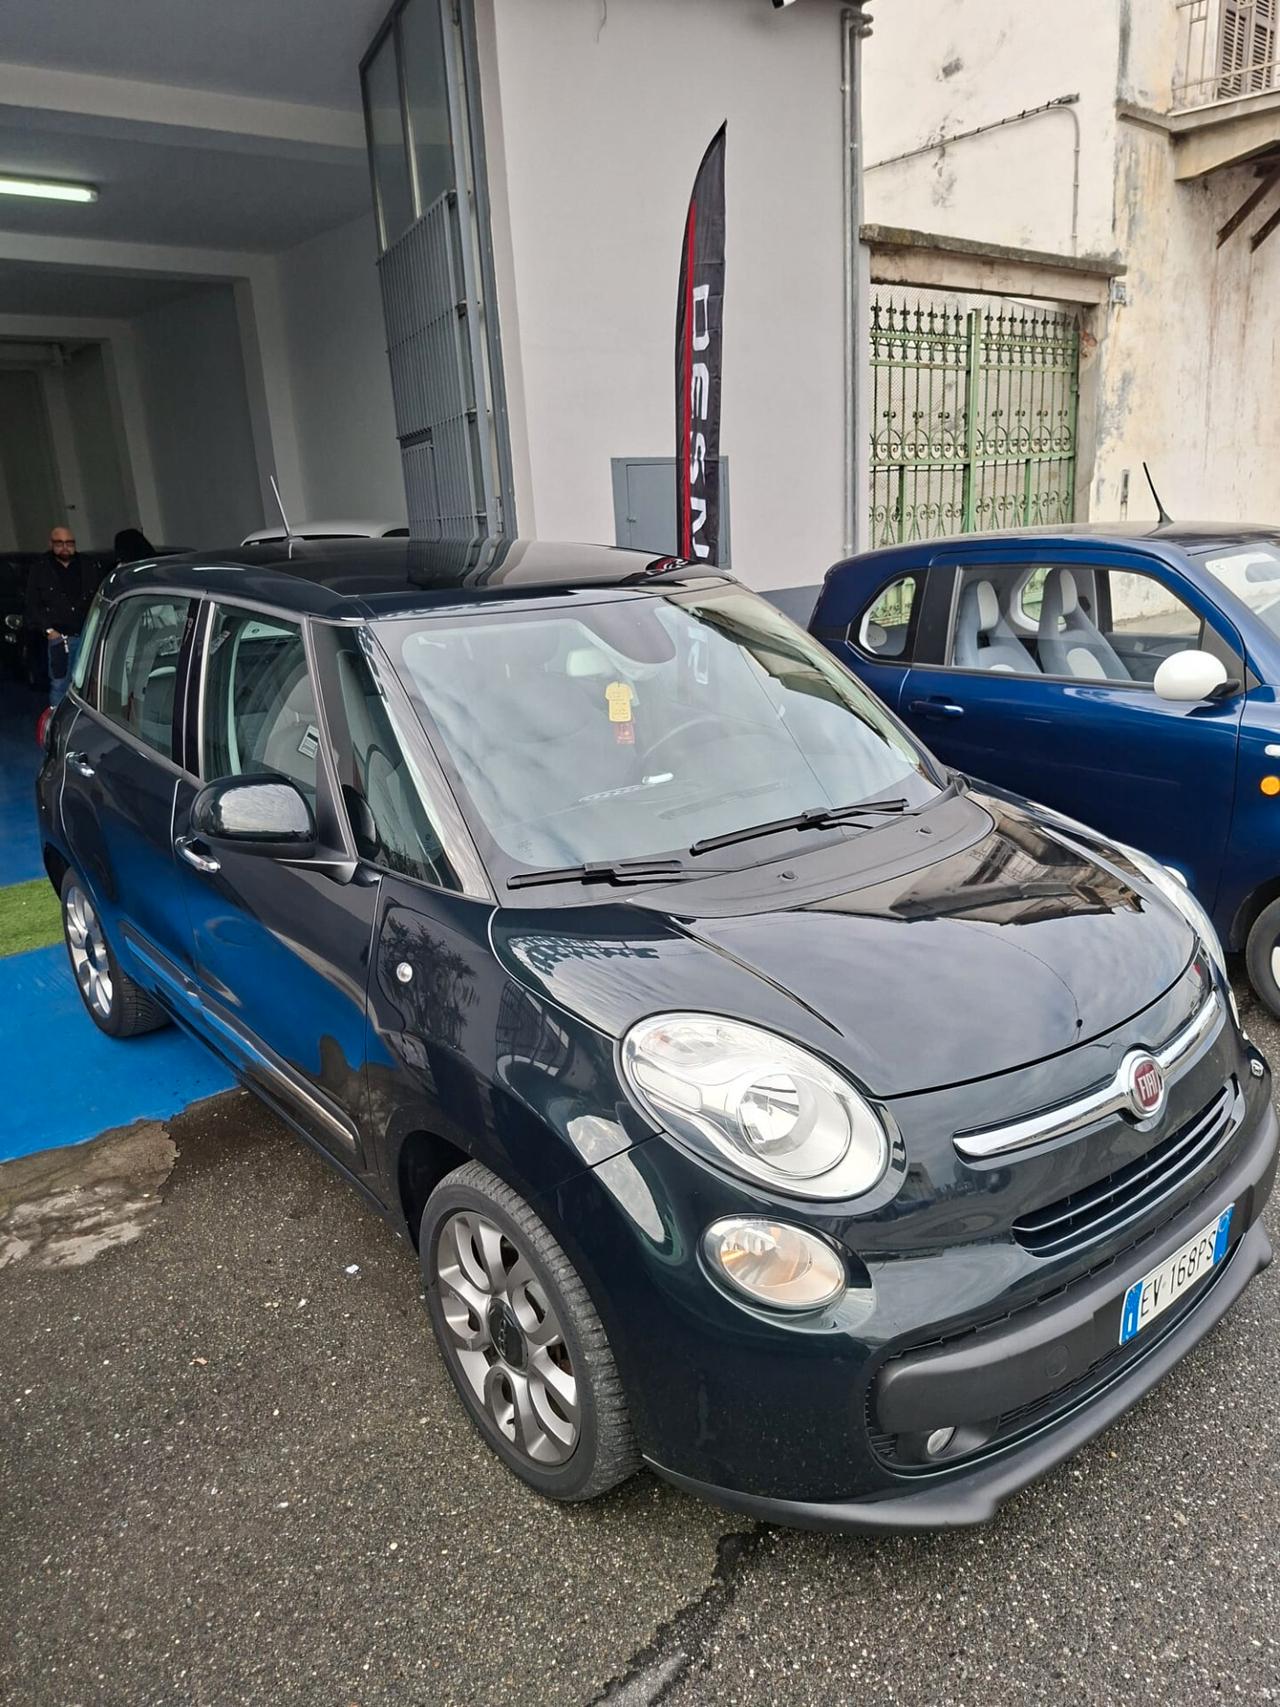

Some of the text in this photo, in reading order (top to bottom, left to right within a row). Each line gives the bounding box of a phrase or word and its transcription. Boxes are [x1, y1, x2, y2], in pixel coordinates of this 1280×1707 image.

[1136, 1069, 1159, 1101] FIAT
[1140, 1274, 1164, 1318] EV
[1169, 1230, 1217, 1295] 168PS
